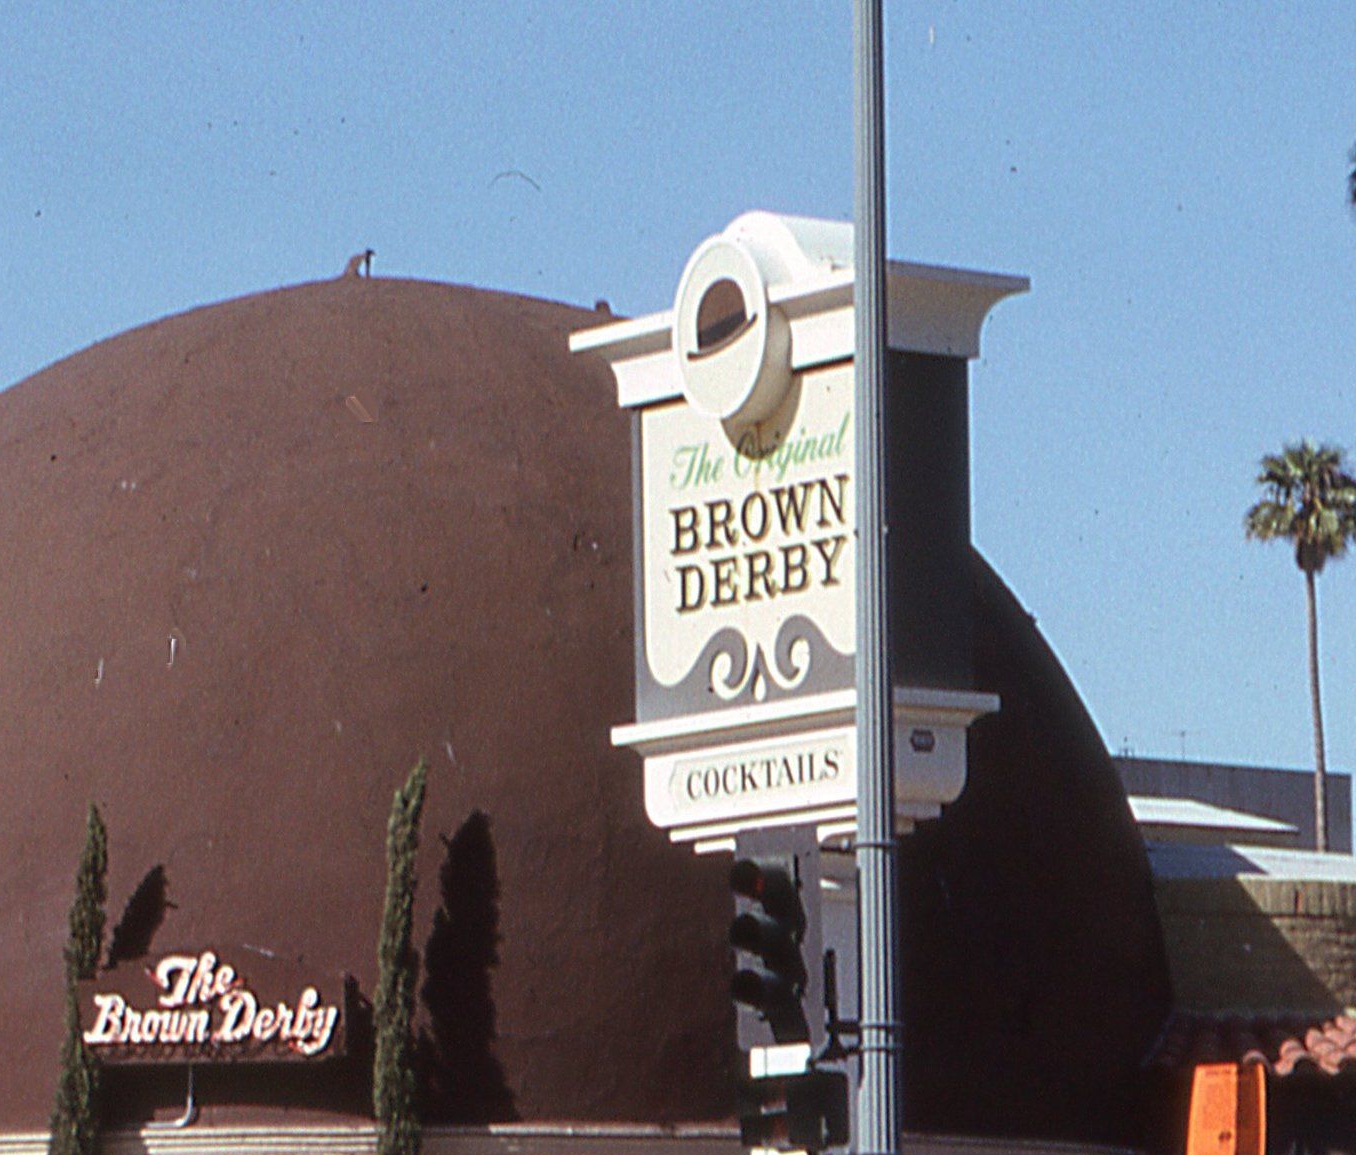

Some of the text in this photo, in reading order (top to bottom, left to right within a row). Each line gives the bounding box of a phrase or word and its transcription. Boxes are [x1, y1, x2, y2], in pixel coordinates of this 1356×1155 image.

[669, 411, 851, 490] The Original
[668, 473, 850, 557] BROWN
[674, 534, 848, 615] DERBY
[686, 748, 841, 801] COCKTAILS
[151, 951, 241, 1008] The
[83, 986, 339, 1056] Brown Derby
